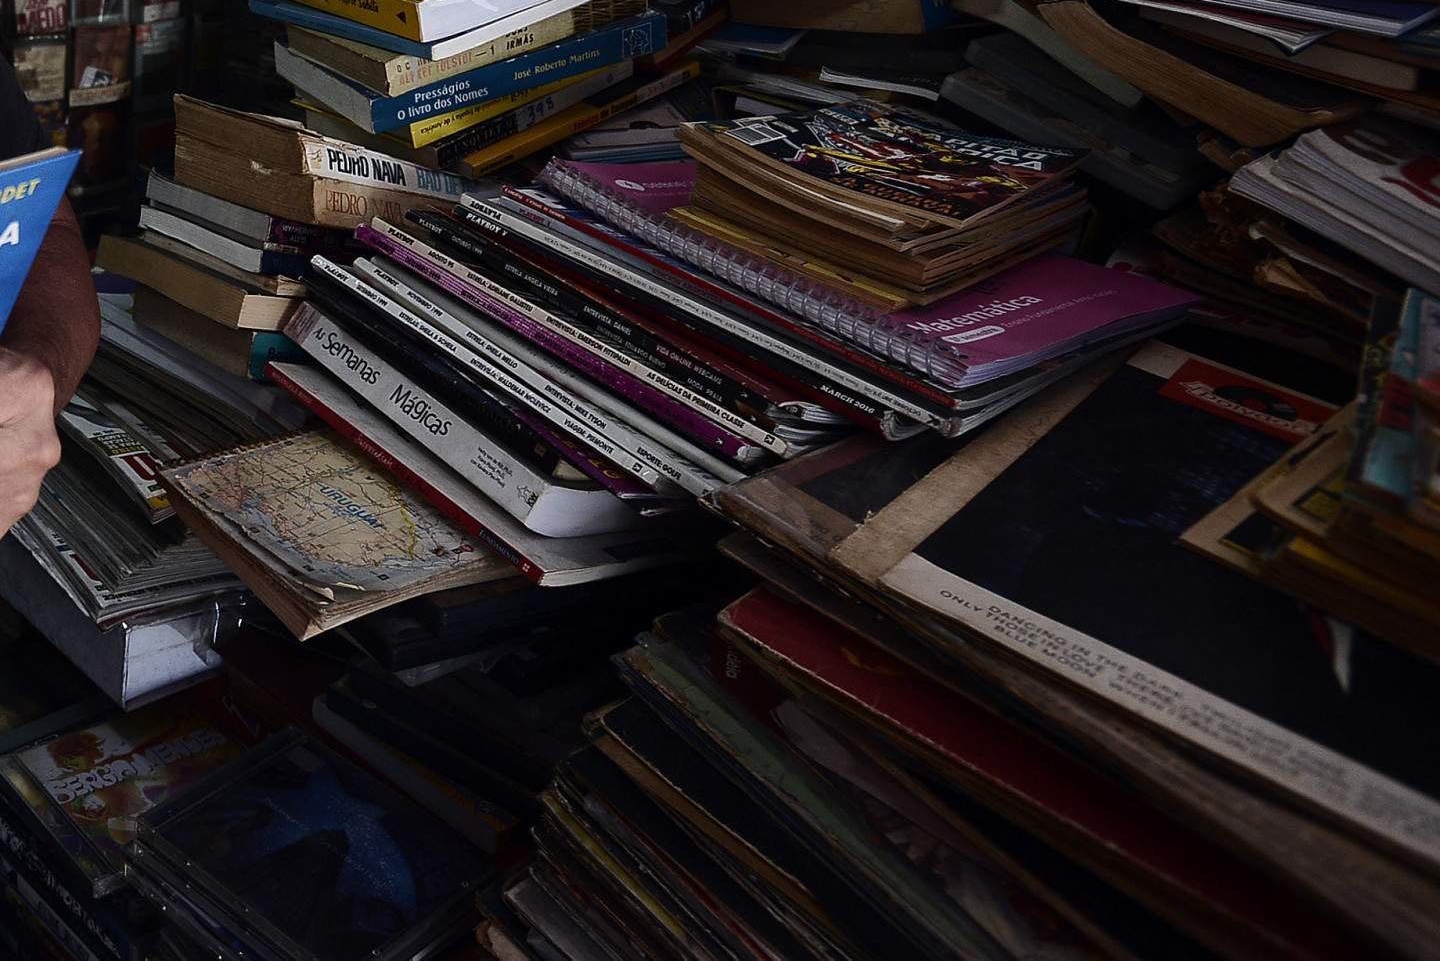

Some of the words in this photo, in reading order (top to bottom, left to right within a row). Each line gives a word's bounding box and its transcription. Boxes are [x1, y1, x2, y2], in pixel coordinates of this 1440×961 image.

[513, 65, 533, 82] José
[534, 56, 568, 78] Roberto
[568, 48, 601, 68] Martins
[396, 109, 408, 122] O
[408, 101, 436, 119] livro
[438, 95, 458, 112] dos
[459, 87, 489, 108] Nomes
[414, 79, 470, 104] Presságios
[327, 148, 369, 180] PEDRO
[371, 157, 407, 187] NAVA
[323, 188, 368, 218] PEDRO
[468, 199, 503, 221] PLAYBOY
[386, 227, 415, 246] PLAYBOY
[417, 216, 443, 236] PLAYBOY
[464, 211, 502, 235] PLAYBOY
[372, 267, 400, 288] PLAYBOY
[906, 291, 1044, 337] Matemática
[483, 342, 503, 359] SHEILA
[499, 353, 519, 369] MELLO
[575, 331, 604, 352] EMERSON
[600, 345, 632, 367] FITTIPALDI
[312, 325, 326, 343] As
[321, 329, 381, 387] Semanas
[388, 381, 453, 438] Mágicas
[691, 364, 723, 387] WEBCAMS
[542, 383, 577, 409] ENTREVISTA:
[573, 403, 590, 418] MIKE
[586, 411, 608, 430] TYSON
[653, 373, 684, 395] DELÍCIAS
[690, 394, 722, 416] PRIMEIRA
[719, 410, 746, 429] CLASSE
[818, 382, 854, 405] MARCH
[851, 398, 876, 415] 2016
[562, 417, 588, 438] VIAGEM:
[584, 432, 614, 454] PIEMONTE
[635, 445, 665, 468] ESPORTE:
[660, 461, 683, 481] GOLFE
[938, 585, 984, 616] ONLY
[983, 607, 1041, 646] THOSE
[987, 600, 1070, 649] DANCING
[992, 621, 1041, 653] BLUE
